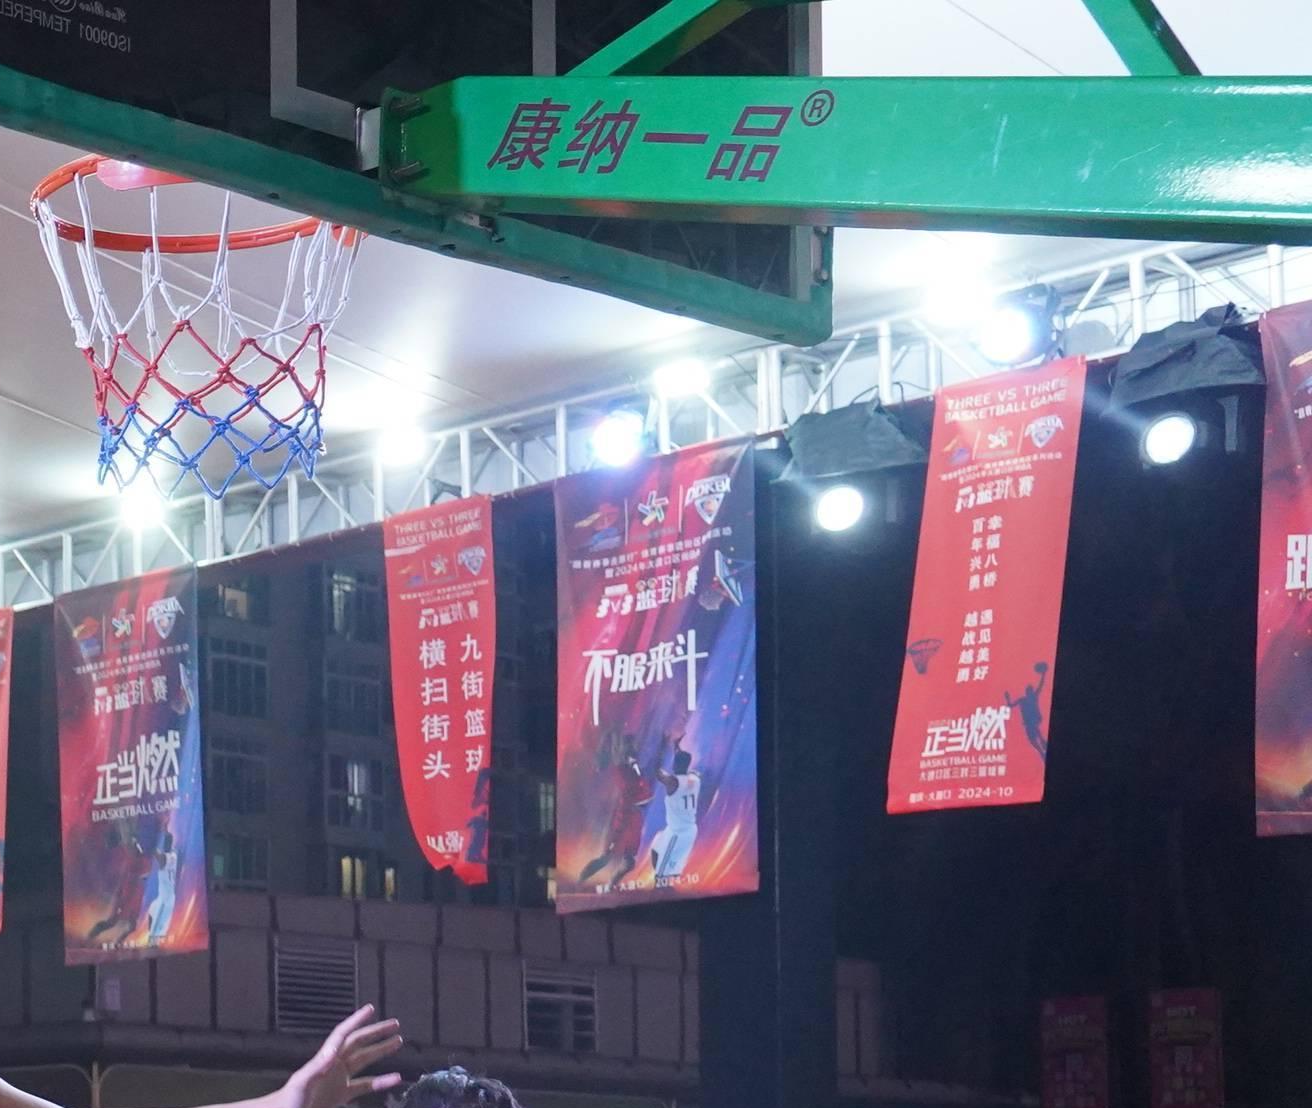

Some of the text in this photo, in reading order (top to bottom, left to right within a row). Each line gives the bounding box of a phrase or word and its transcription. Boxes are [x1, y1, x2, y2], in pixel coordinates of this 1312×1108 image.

[486, 97, 794, 182] 康纳一品
[946, 378, 1069, 411] THREE VS THREE
[1031, 389, 1066, 409] GAME
[459, 634, 486, 773] 九街篮球
[582, 629, 709, 726] 不服来斗
[418, 640, 451, 780] 横扫街头
[921, 706, 1011, 757] 正当燃
[92, 728, 181, 806] 正当燃
[959, 786, 1014, 799] 2024-10
[92, 798, 181, 822] BASKETBALL GAME
